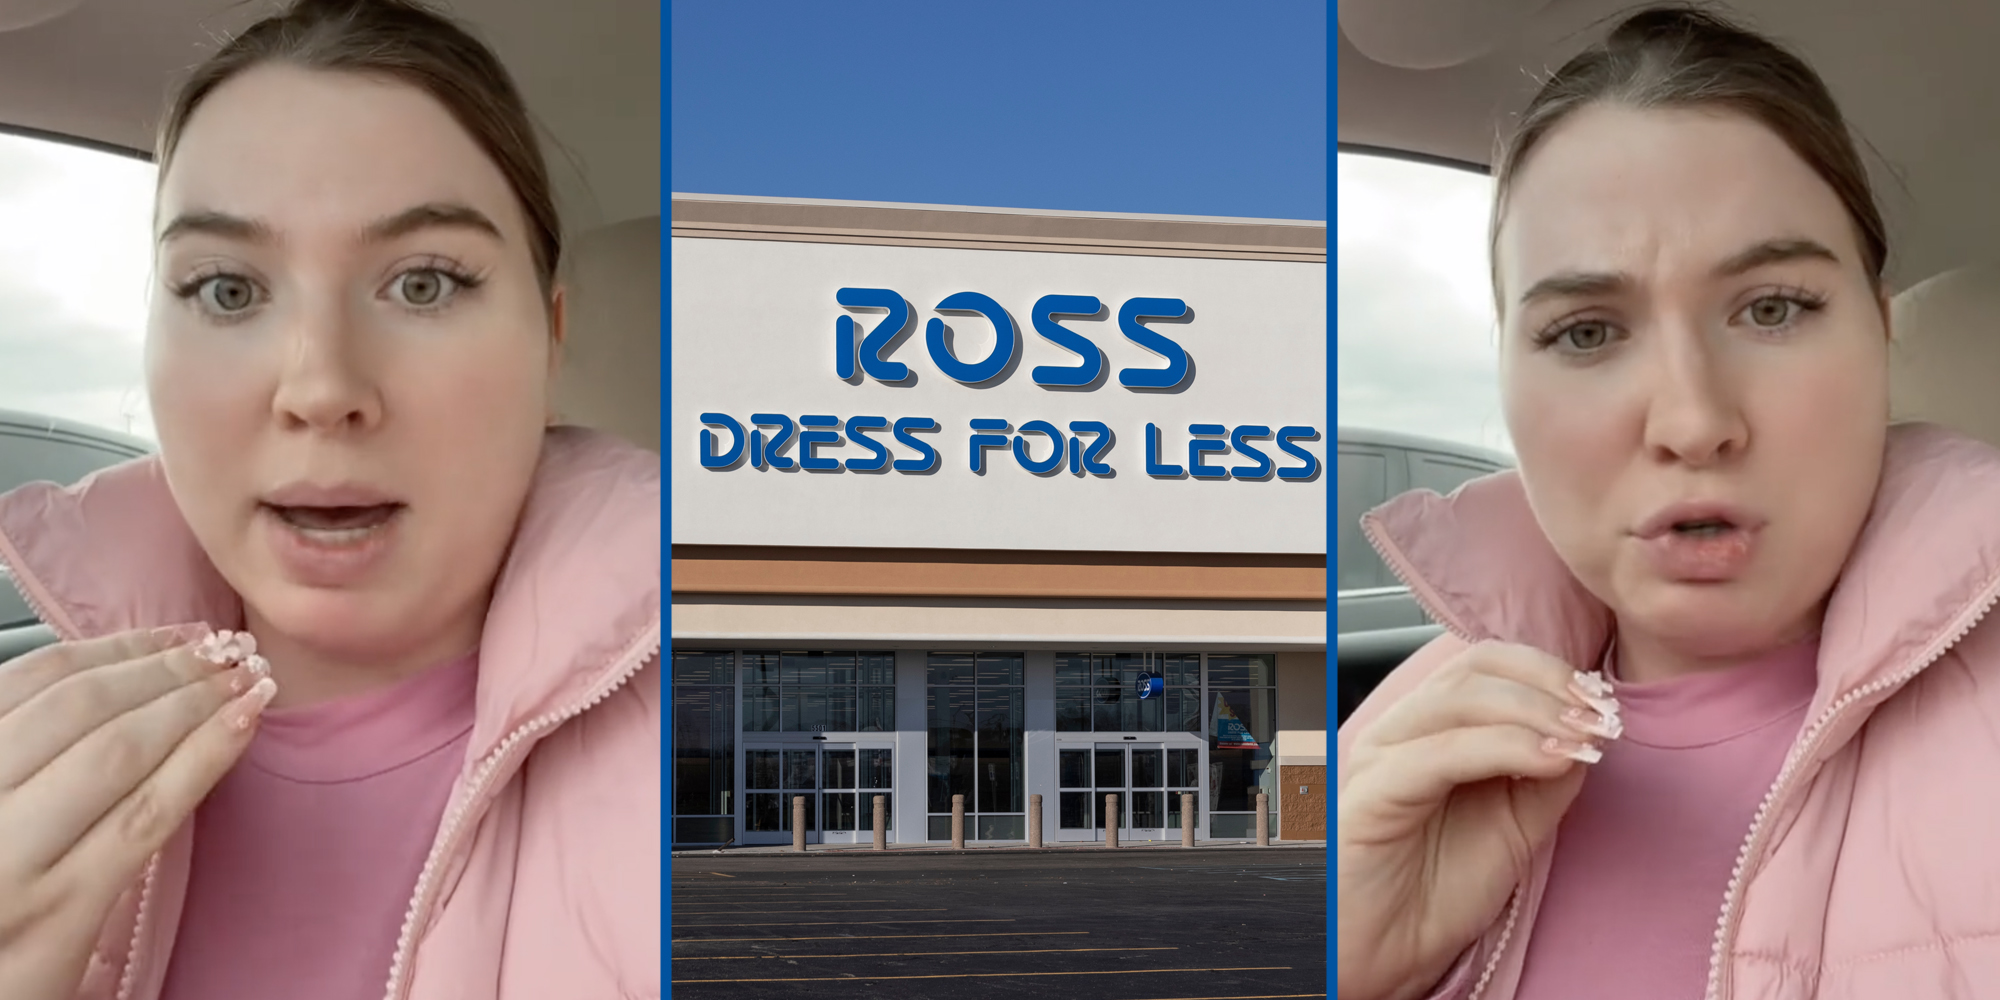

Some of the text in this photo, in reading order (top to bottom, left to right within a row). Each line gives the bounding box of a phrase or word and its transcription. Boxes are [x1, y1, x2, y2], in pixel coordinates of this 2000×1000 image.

[836, 287, 1189, 388] ROSS
[699, 412, 1318, 479] DRESS FOR LESS
[811, 724, 826, 732] 5501
